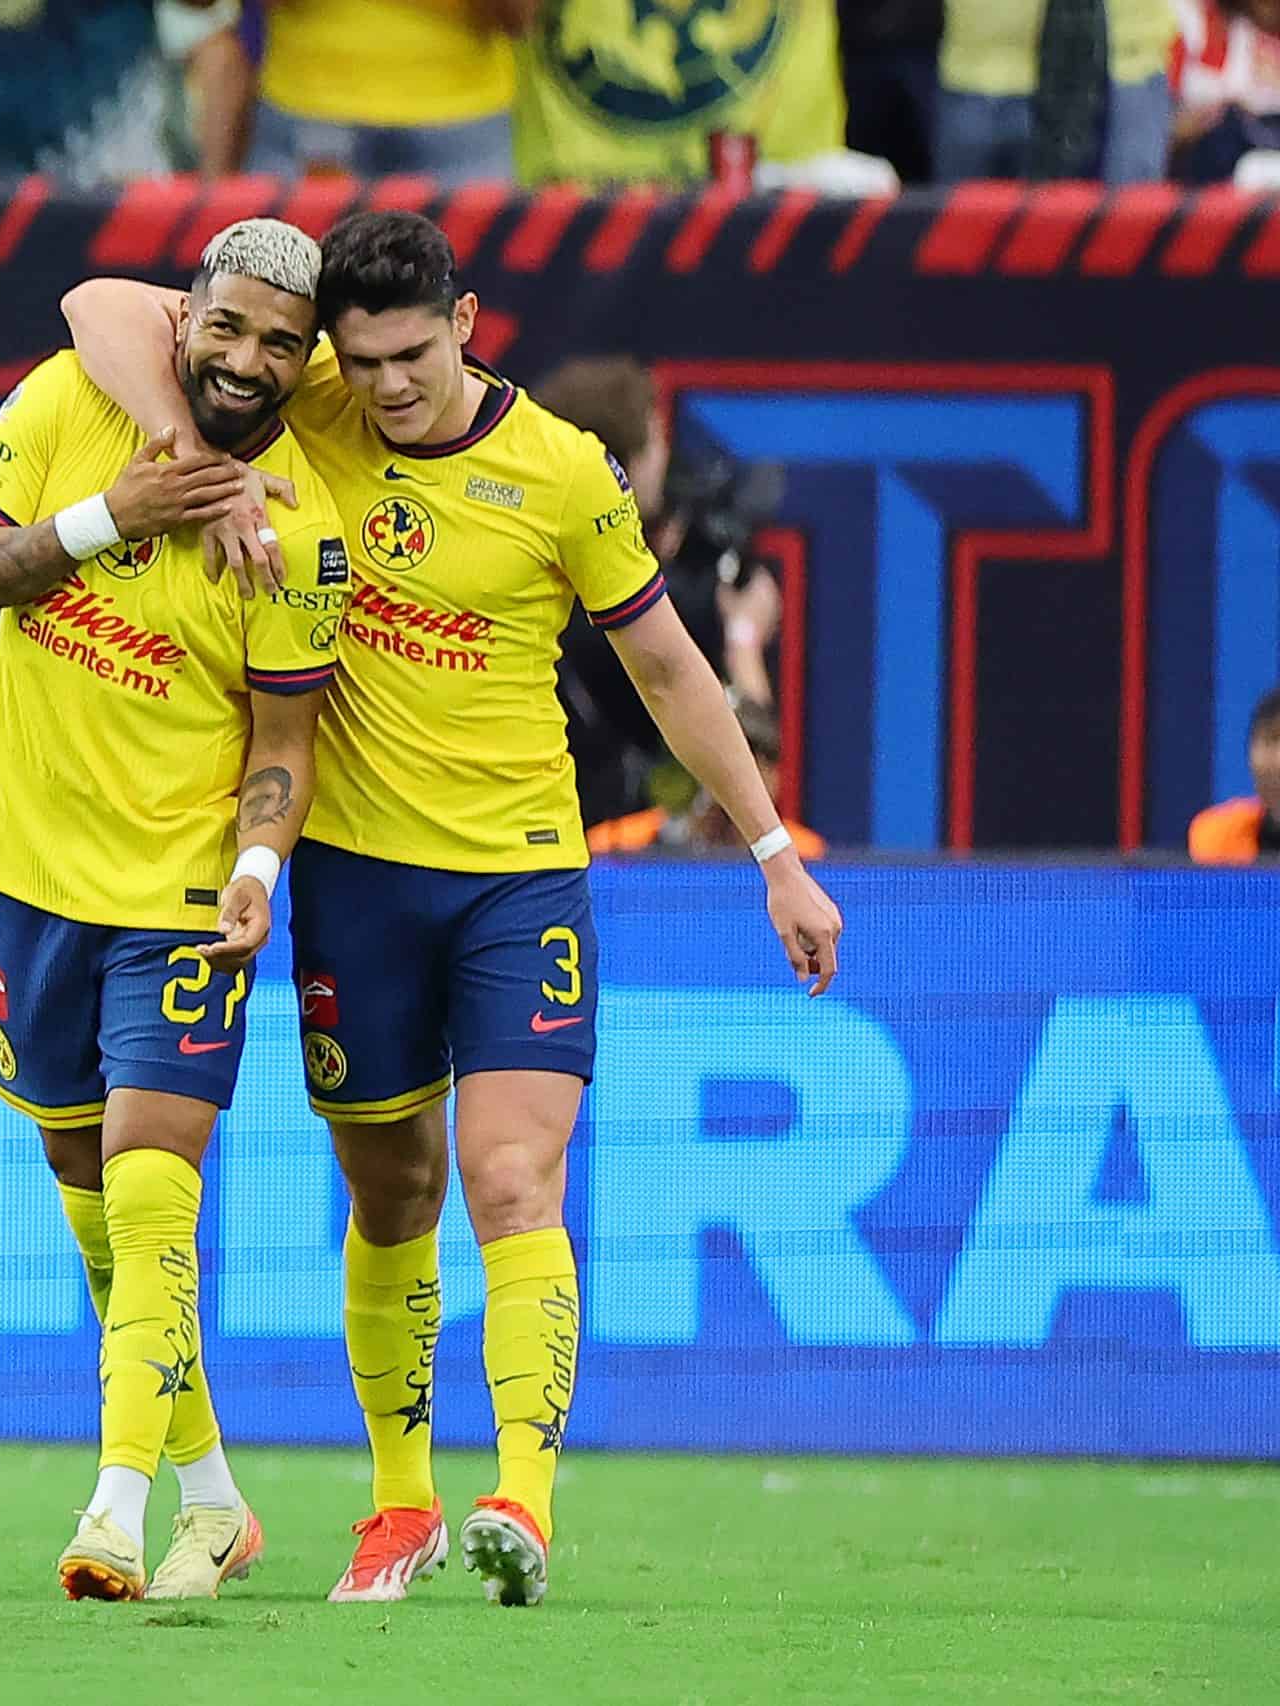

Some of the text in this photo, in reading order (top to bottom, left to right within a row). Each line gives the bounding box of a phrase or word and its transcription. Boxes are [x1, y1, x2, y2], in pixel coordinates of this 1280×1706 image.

[33, 573, 187, 668] aliente
[539, 925, 582, 1006] 3
[541, 1327, 576, 1415] Carl's
